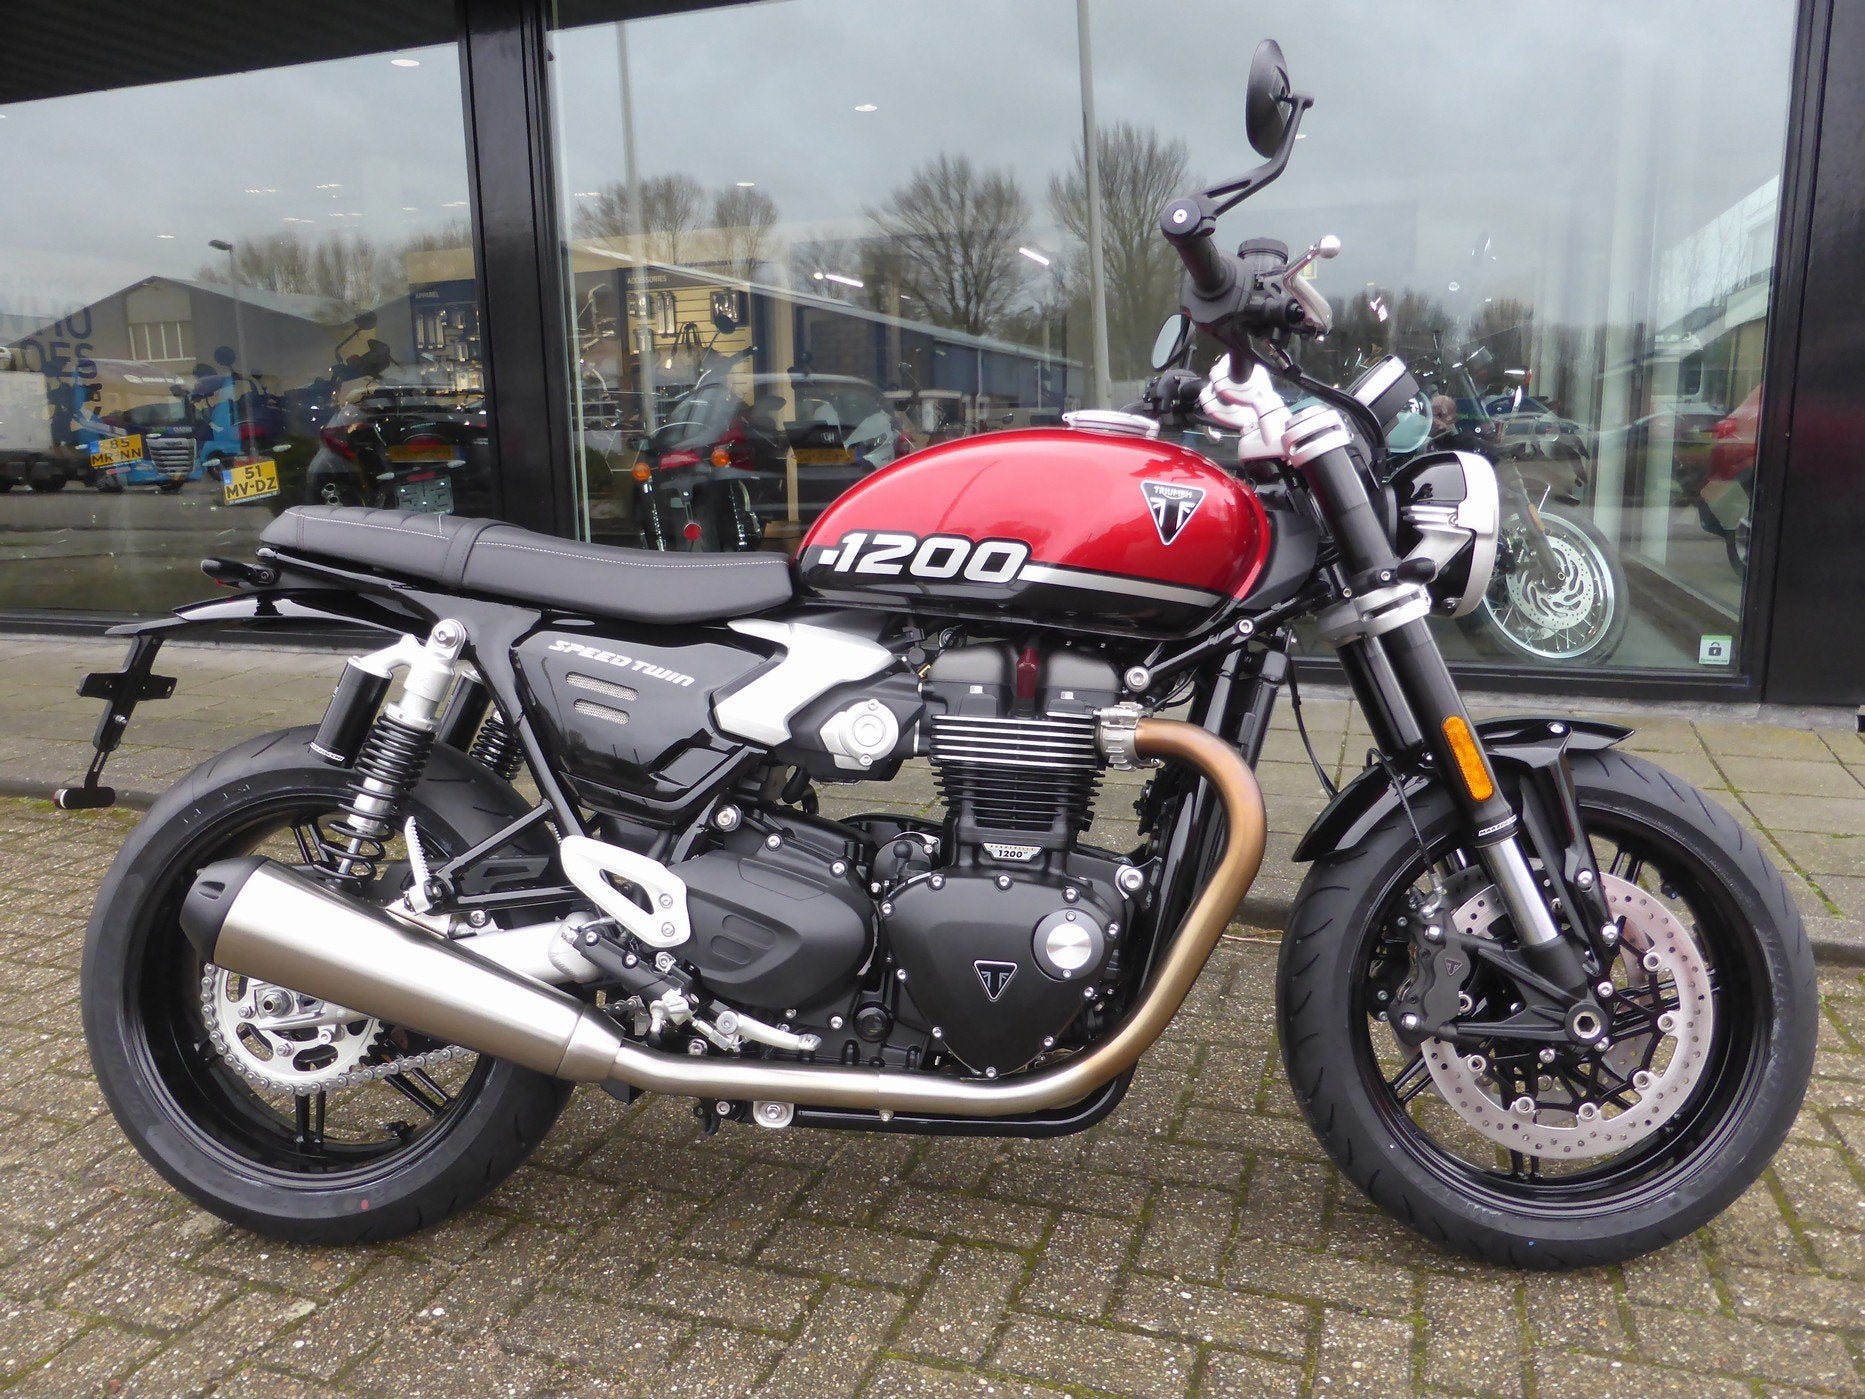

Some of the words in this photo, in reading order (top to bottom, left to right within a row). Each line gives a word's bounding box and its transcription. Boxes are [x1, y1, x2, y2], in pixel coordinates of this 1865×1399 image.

[110, 438, 130, 449] 85
[244, 465, 261, 480] 51
[226, 476, 277, 499] MV-DZ
[1153, 485, 1193, 499] TRIUMPH
[834, 533, 1029, 583] 1200
[548, 640, 632, 667] SPEED
[631, 660, 695, 687] TWIN
[998, 849, 1023, 858] 1200
